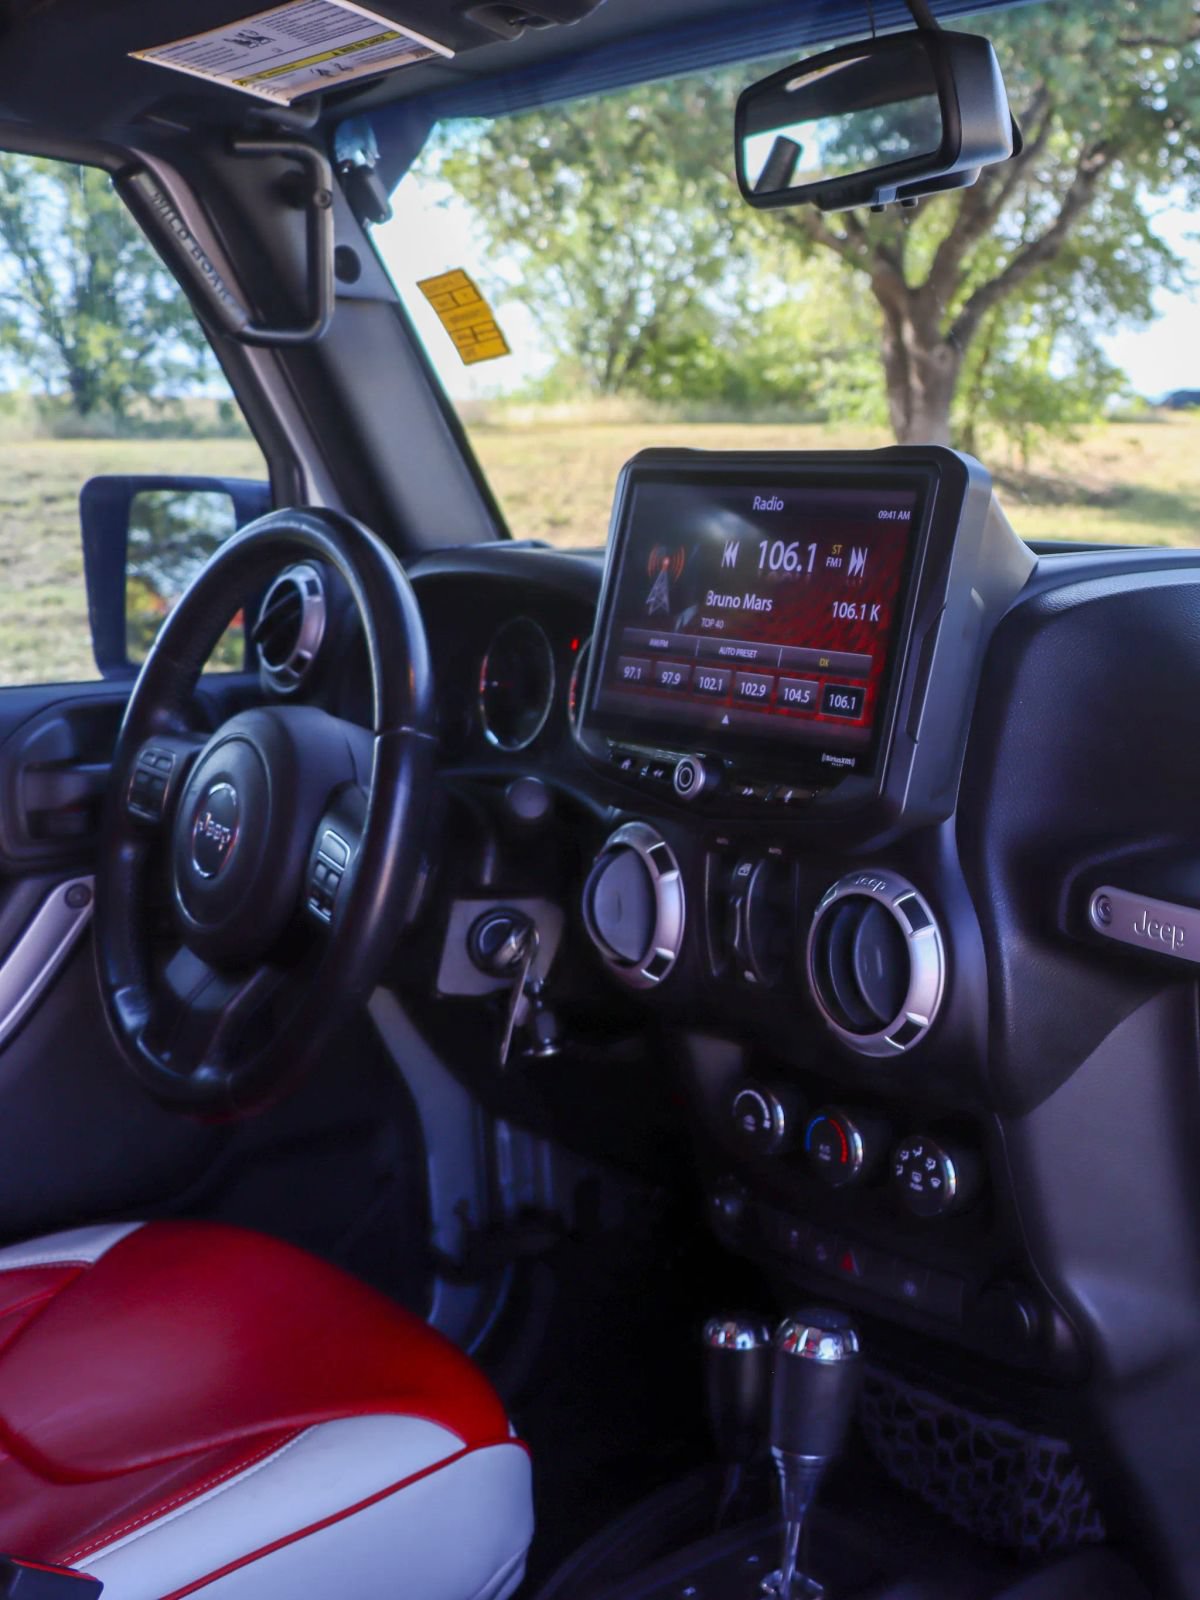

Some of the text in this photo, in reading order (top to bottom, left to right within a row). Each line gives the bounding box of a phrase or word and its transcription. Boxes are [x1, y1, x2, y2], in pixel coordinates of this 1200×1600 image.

[152, 192, 190, 241] WILD
[752, 496, 785, 512] Radio
[896, 511, 911, 521] AM
[758, 540, 818, 573] 106.1
[831, 544, 843, 555] ST
[826, 556, 843, 568] FM1
[706, 589, 773, 612] Bruno Mars
[832, 601, 882, 622] 106.1 K
[718, 646, 758, 659] AUTO PRESET
[623, 664, 641, 680] 97.1
[661, 670, 681, 685] 97.9
[699, 676, 724, 692] 102.1
[740, 681, 766, 698] 102.9
[783, 687, 811, 704] 104.5
[829, 693, 857, 710] 106.1
[199, 811, 231, 852] Jeep
[1132, 907, 1186, 950] Jeep
